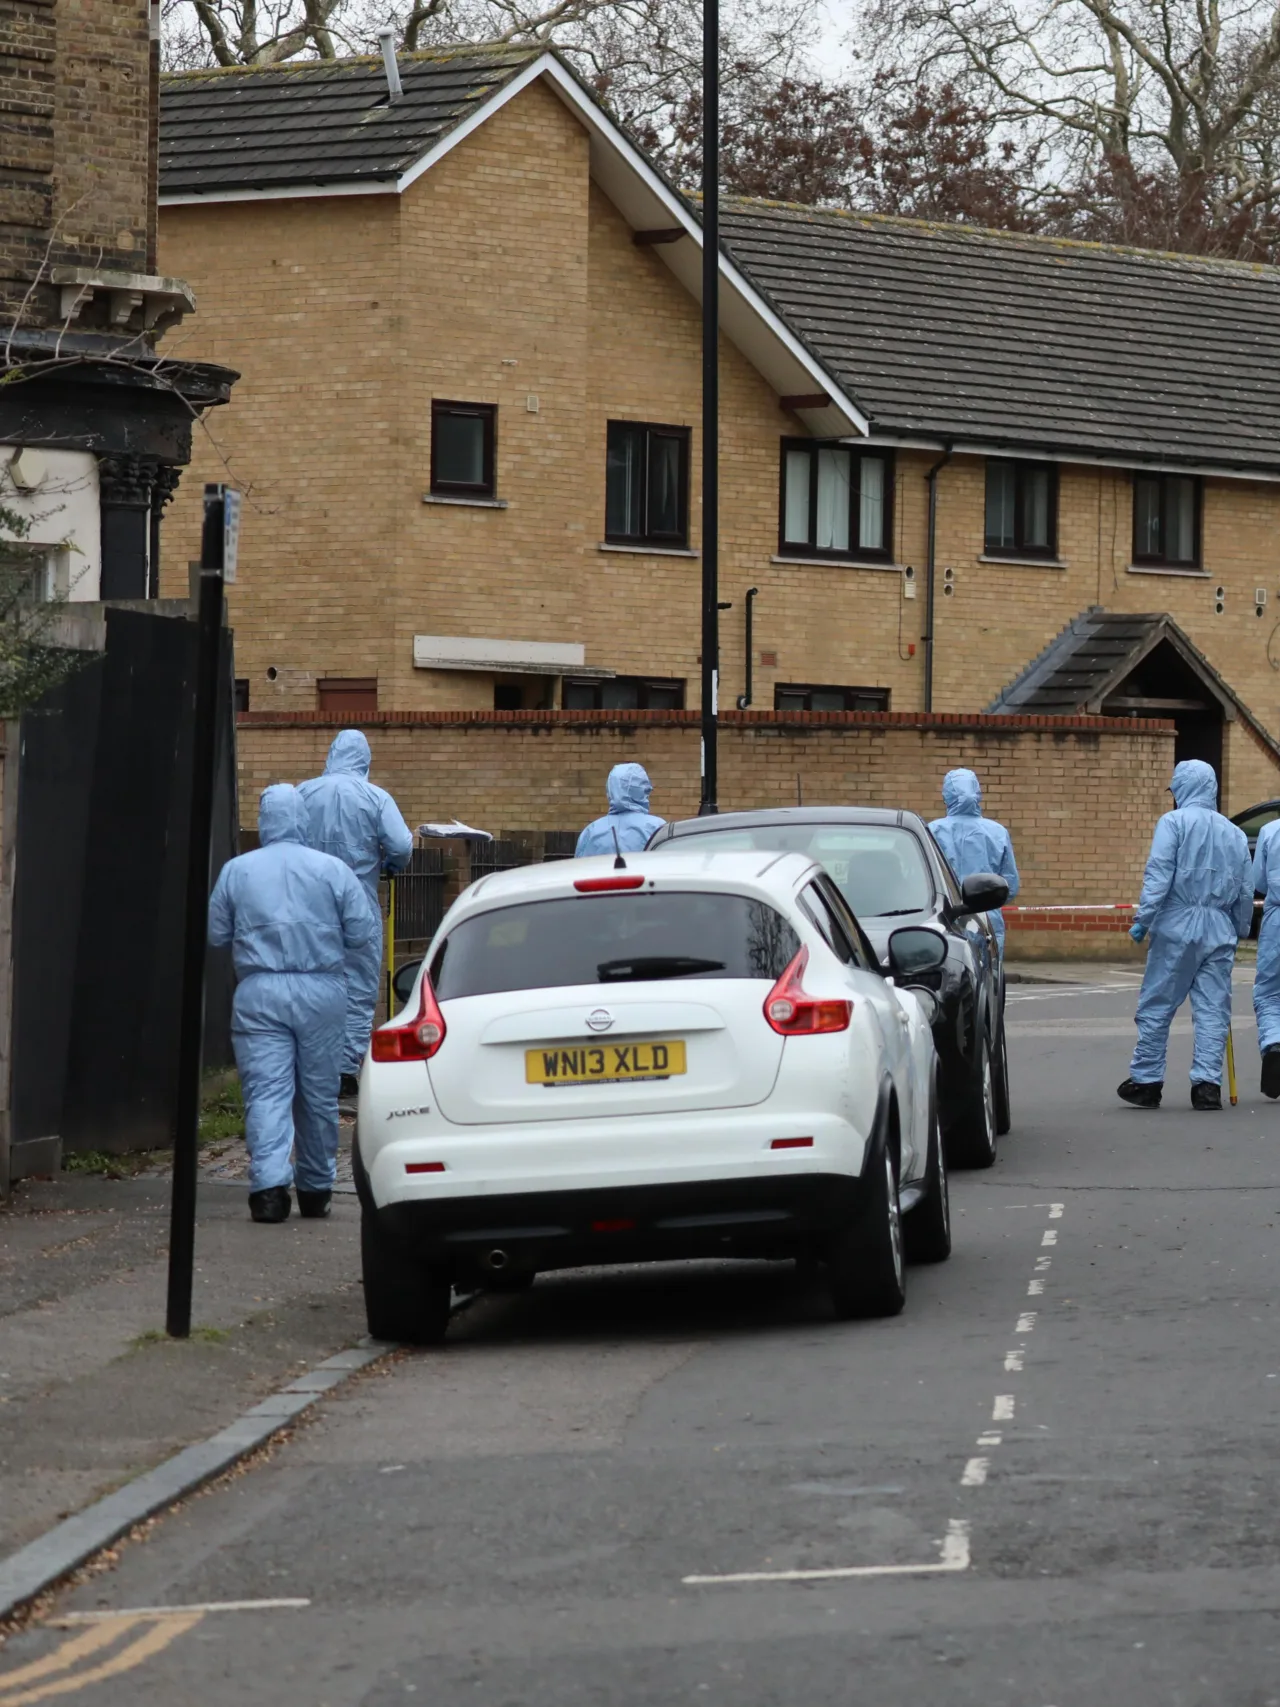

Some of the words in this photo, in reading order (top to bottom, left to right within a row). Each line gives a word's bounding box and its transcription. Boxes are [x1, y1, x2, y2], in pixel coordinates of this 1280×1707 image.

[542, 1049, 605, 1077] WN13
[614, 1045, 669, 1073] XLD
[385, 1105, 430, 1121] JUKE
